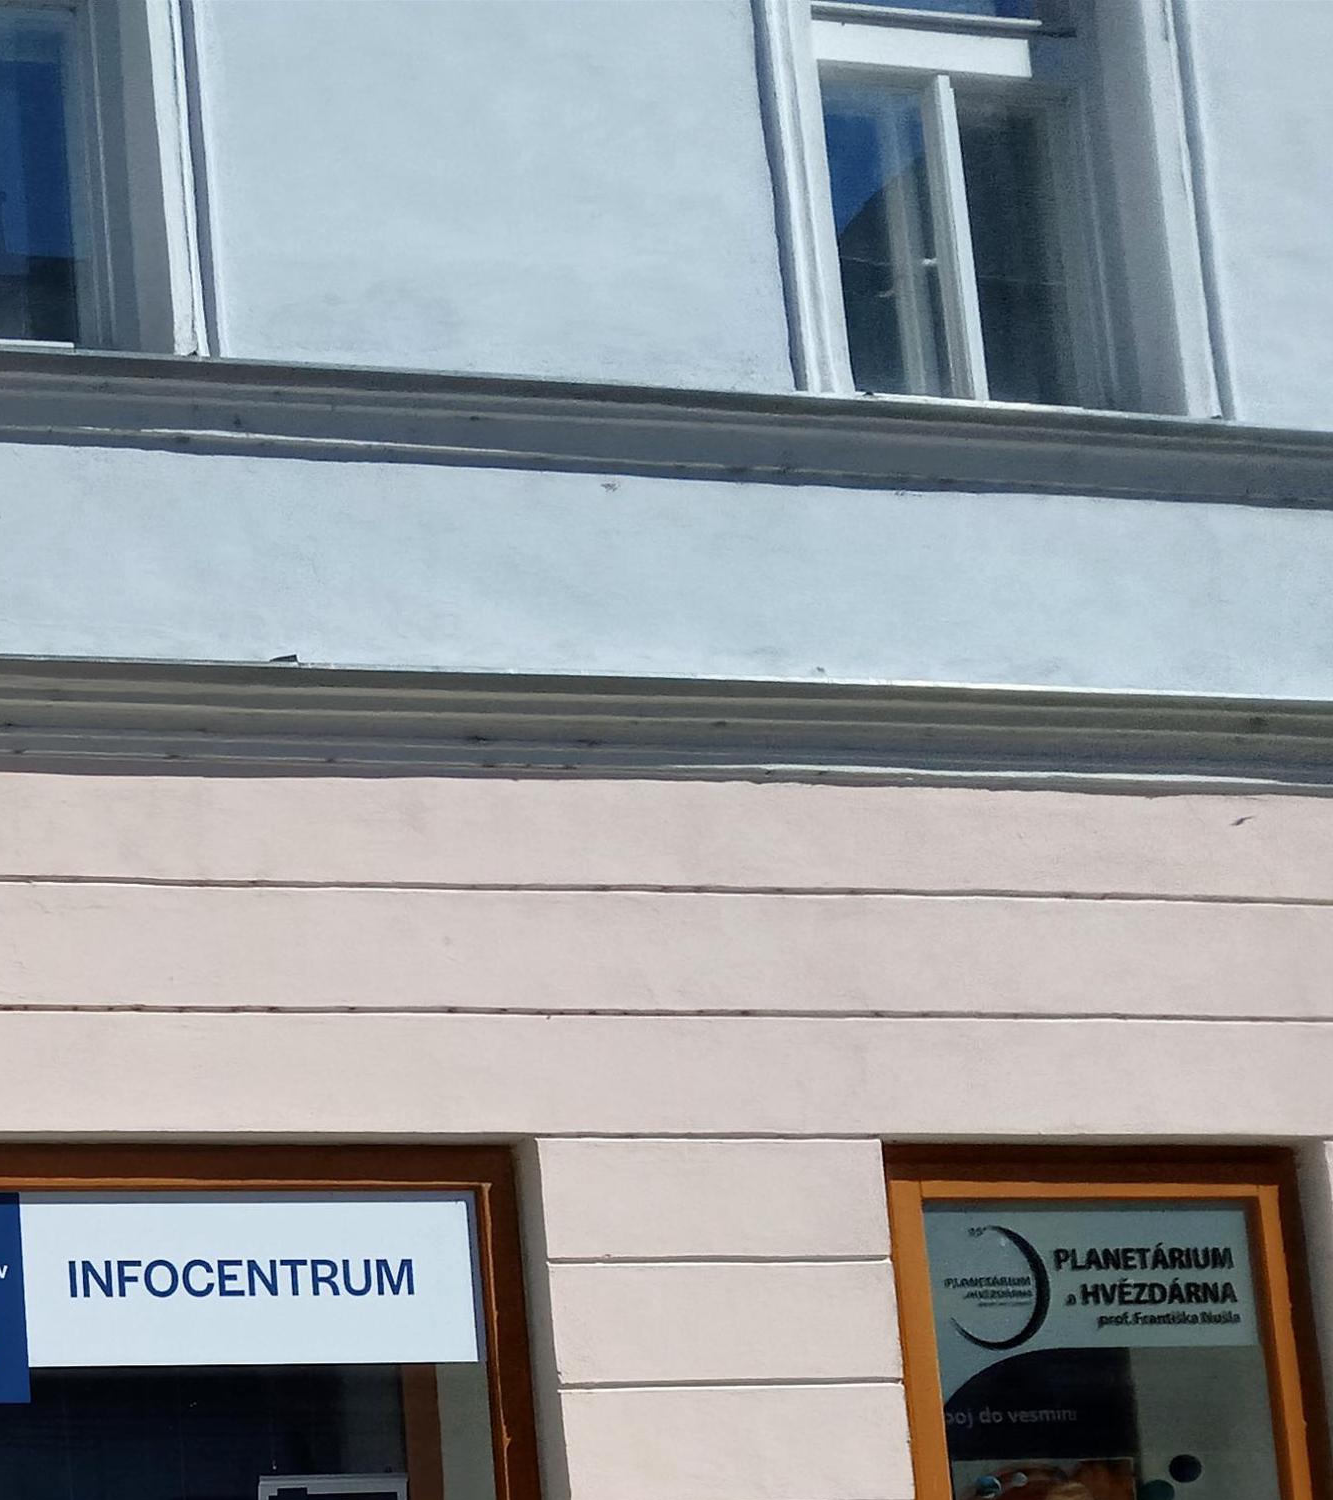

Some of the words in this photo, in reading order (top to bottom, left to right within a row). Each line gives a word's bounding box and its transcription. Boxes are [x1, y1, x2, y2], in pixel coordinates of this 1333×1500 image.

[1053, 1242, 1235, 1271] PLANETÁRIUM
[67, 1258, 416, 1298] INFOCENTRUM
[1097, 1311, 1132, 1329] prof.
[979, 1406, 1003, 1424] do
